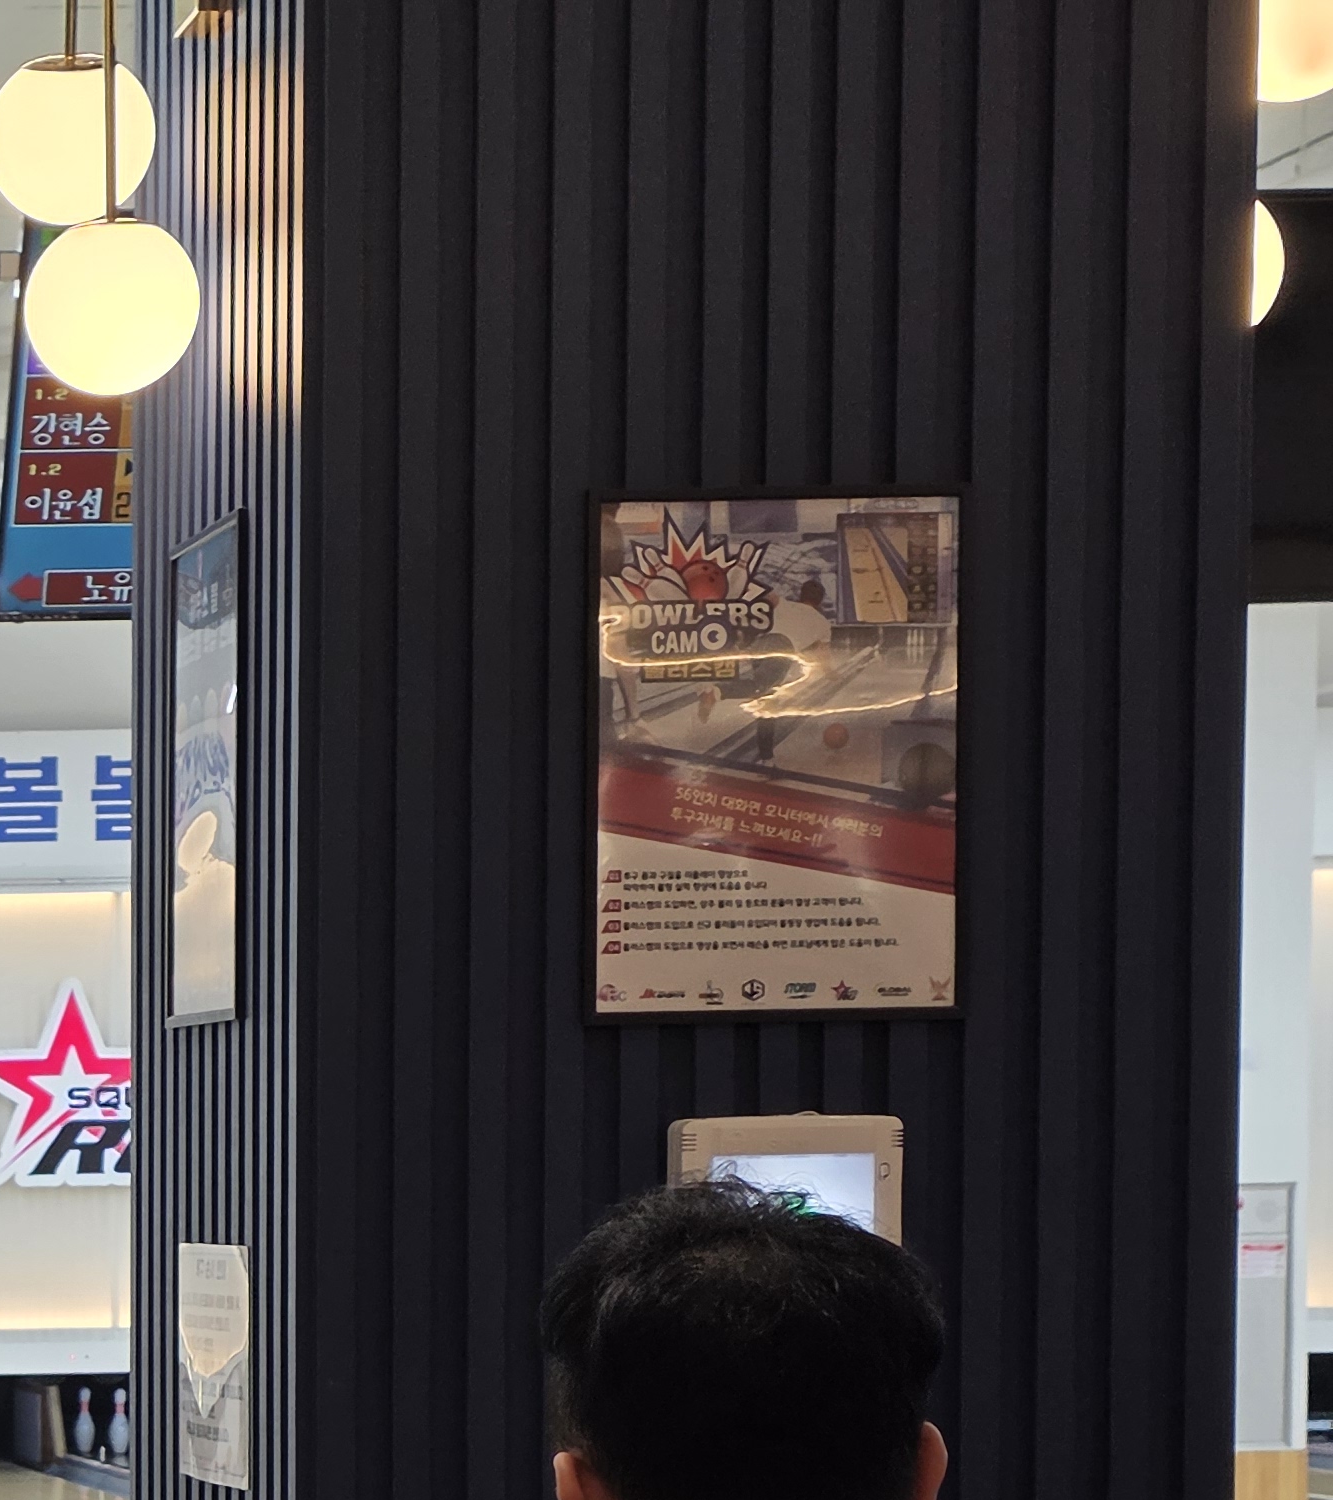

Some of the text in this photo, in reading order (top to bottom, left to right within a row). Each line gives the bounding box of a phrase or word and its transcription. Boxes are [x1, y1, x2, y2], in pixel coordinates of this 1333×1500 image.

[34, 388, 70, 401] 1.2
[30, 412, 112, 446] 강현승
[27, 463, 63, 477] 1.2
[24, 487, 104, 521] 이윤섭
[27, 1118, 131, 1176] R
